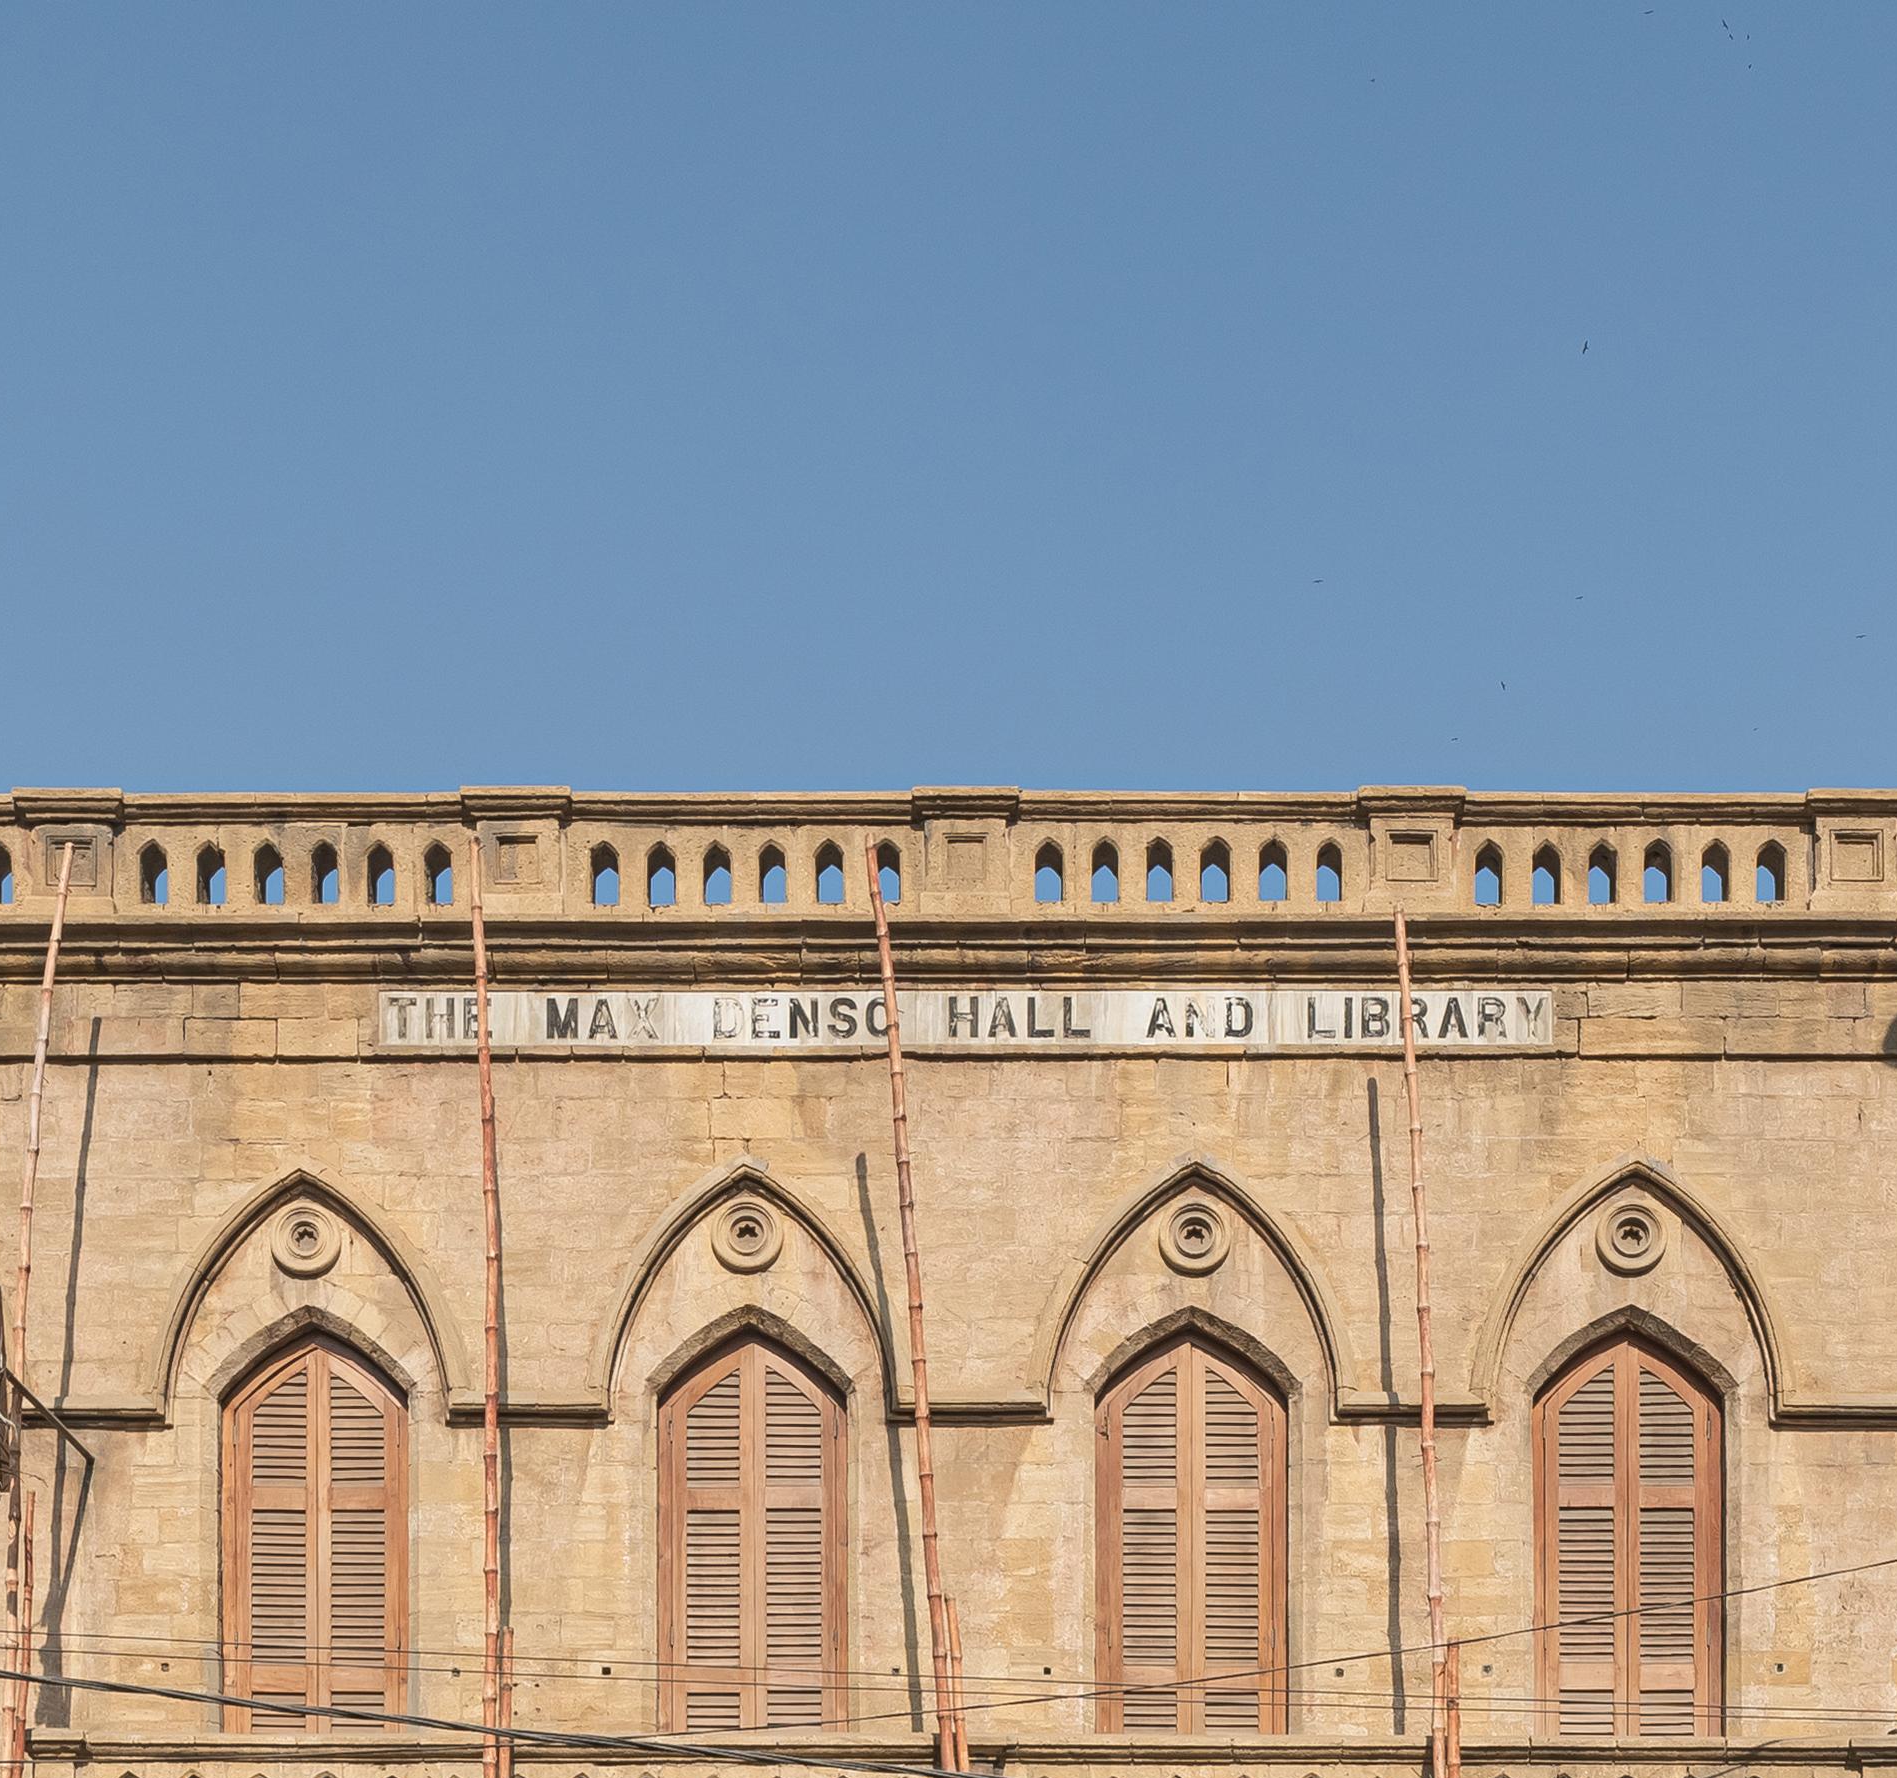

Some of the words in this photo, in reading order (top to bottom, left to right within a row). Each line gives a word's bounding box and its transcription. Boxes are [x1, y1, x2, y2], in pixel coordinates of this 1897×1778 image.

[388, 997, 493, 1039] THE
[546, 997, 660, 1039] MAX
[948, 996, 1092, 1039] HALL
[1145, 996, 1254, 1038] AND
[1307, 996, 1548, 1039] LIBRARY
